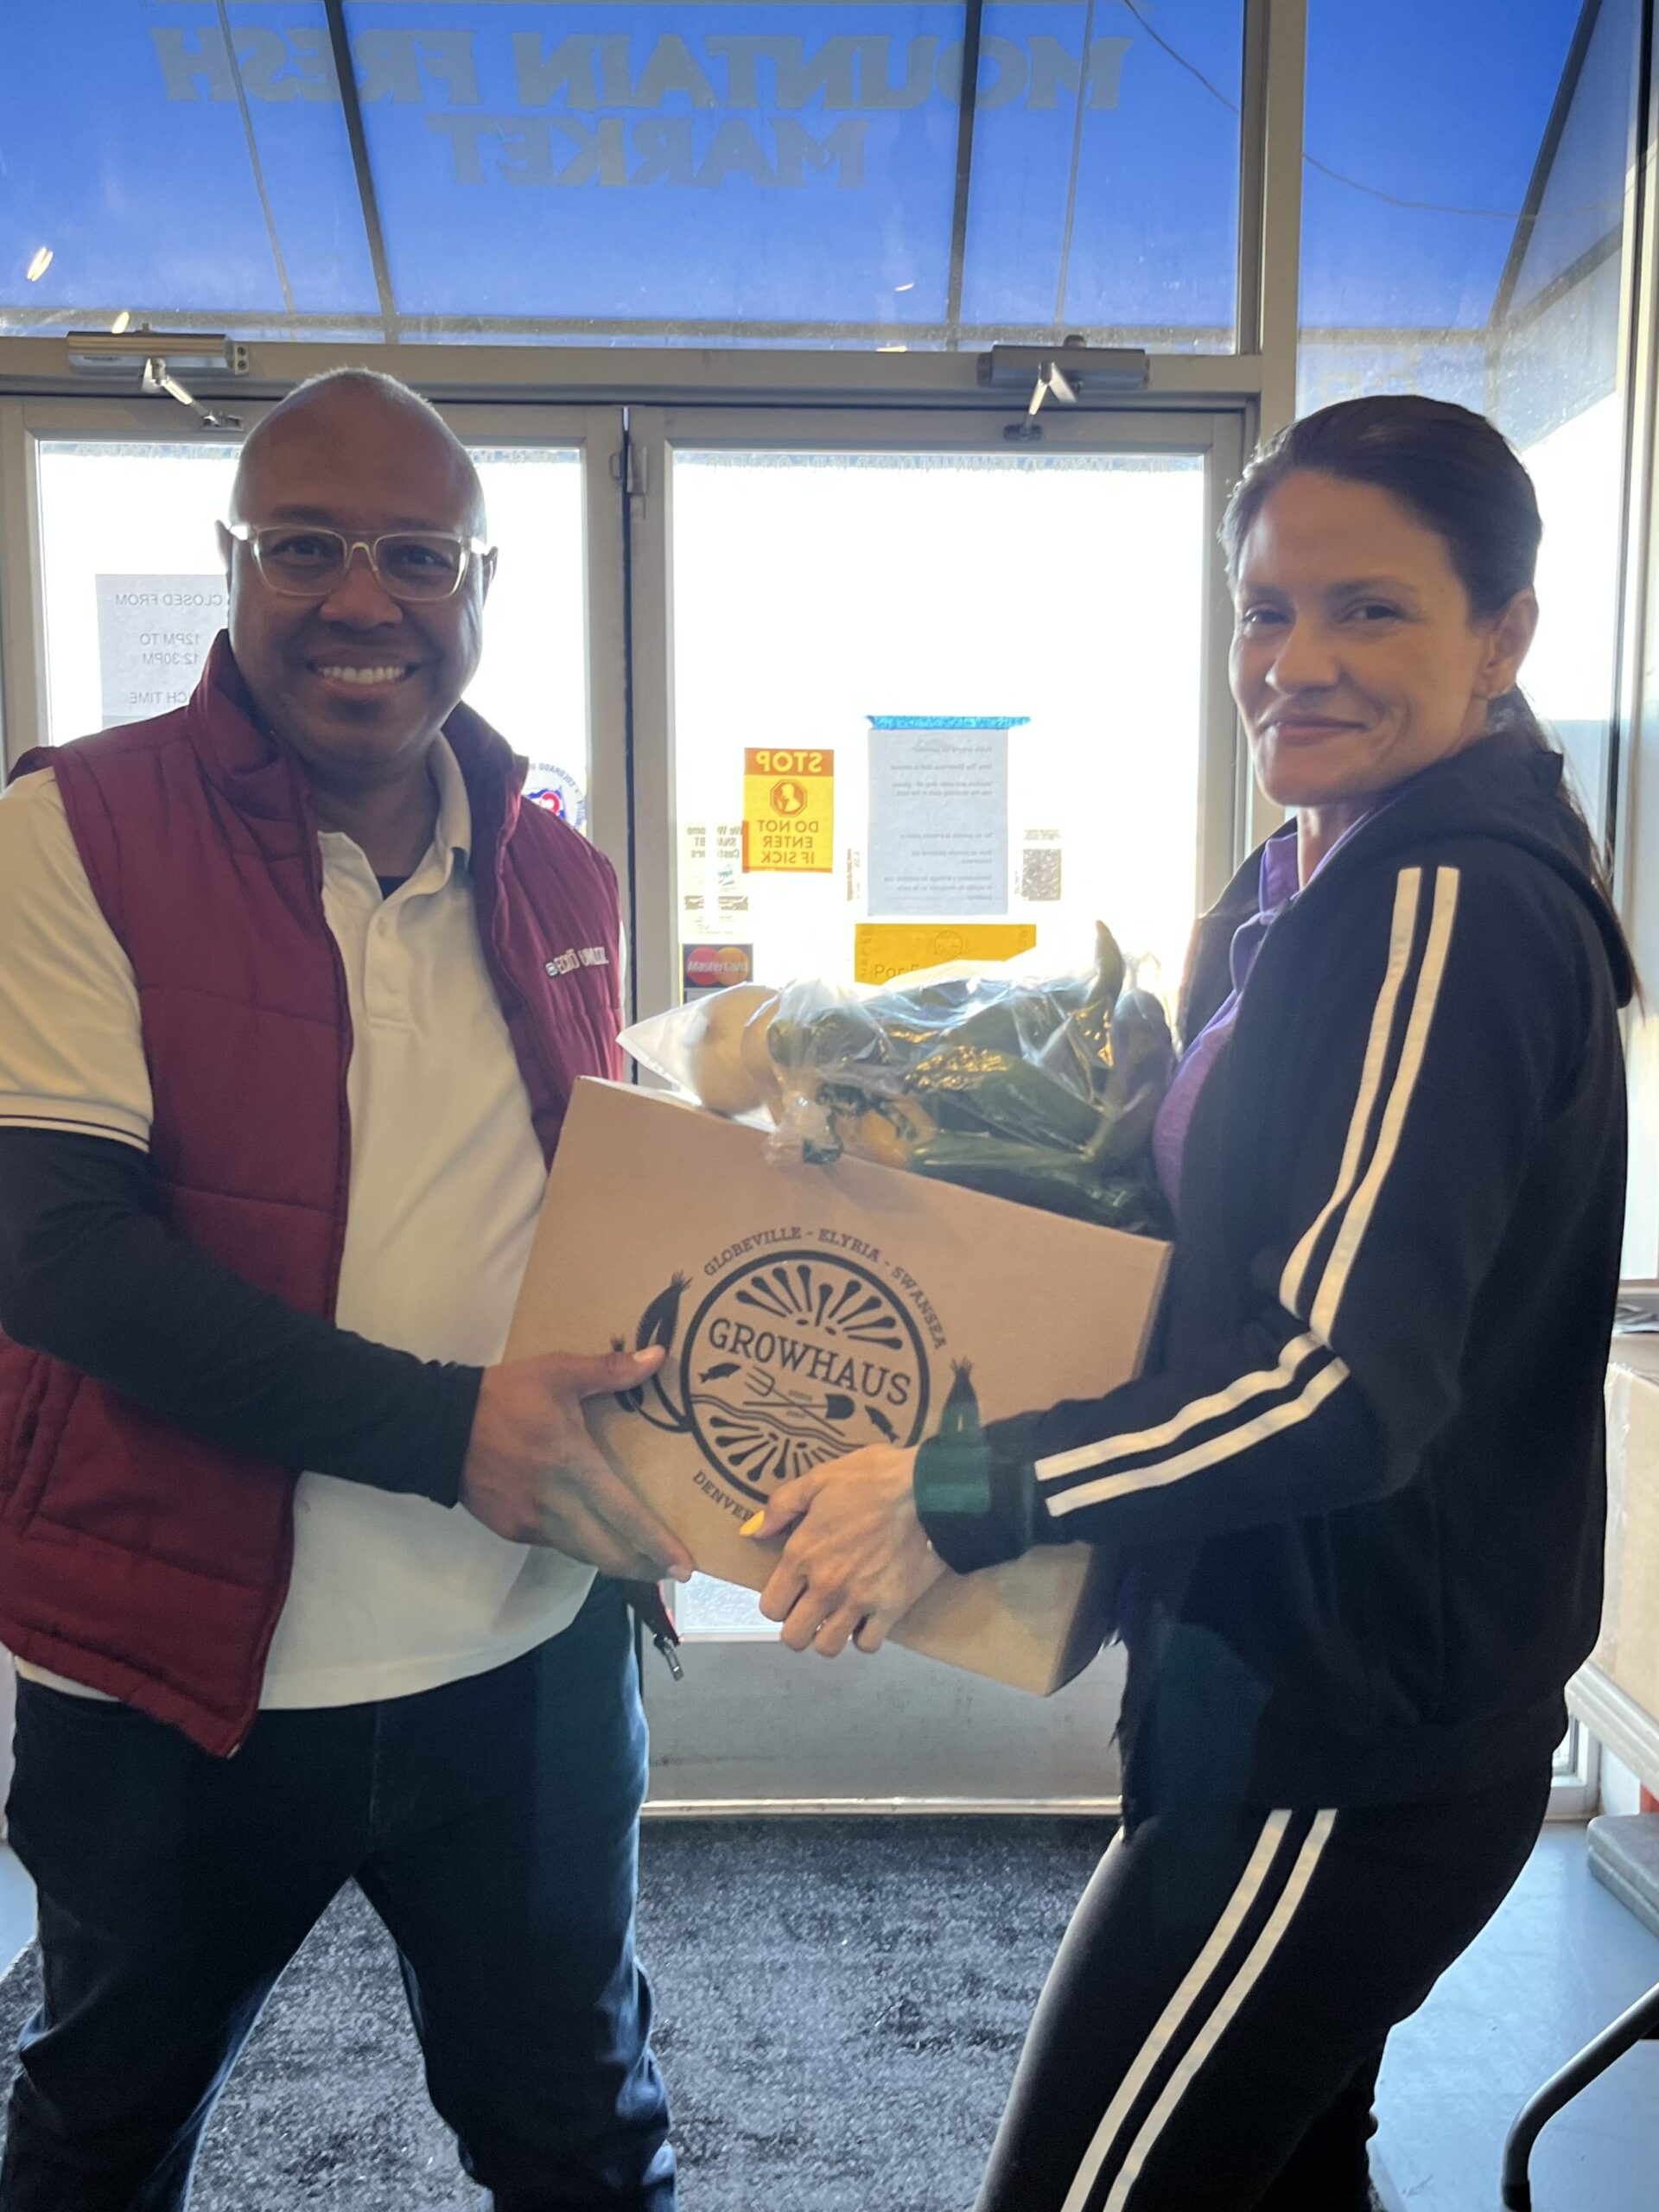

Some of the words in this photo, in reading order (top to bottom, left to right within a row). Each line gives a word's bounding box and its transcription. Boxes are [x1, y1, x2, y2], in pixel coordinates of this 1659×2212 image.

[703, 1226, 802, 1276] GLOBEVILLE
[817, 1228, 881, 1263] ELYRIA
[891, 1265, 947, 1350] SWANSEA
[708, 1317, 912, 1407] GROWHAUS
